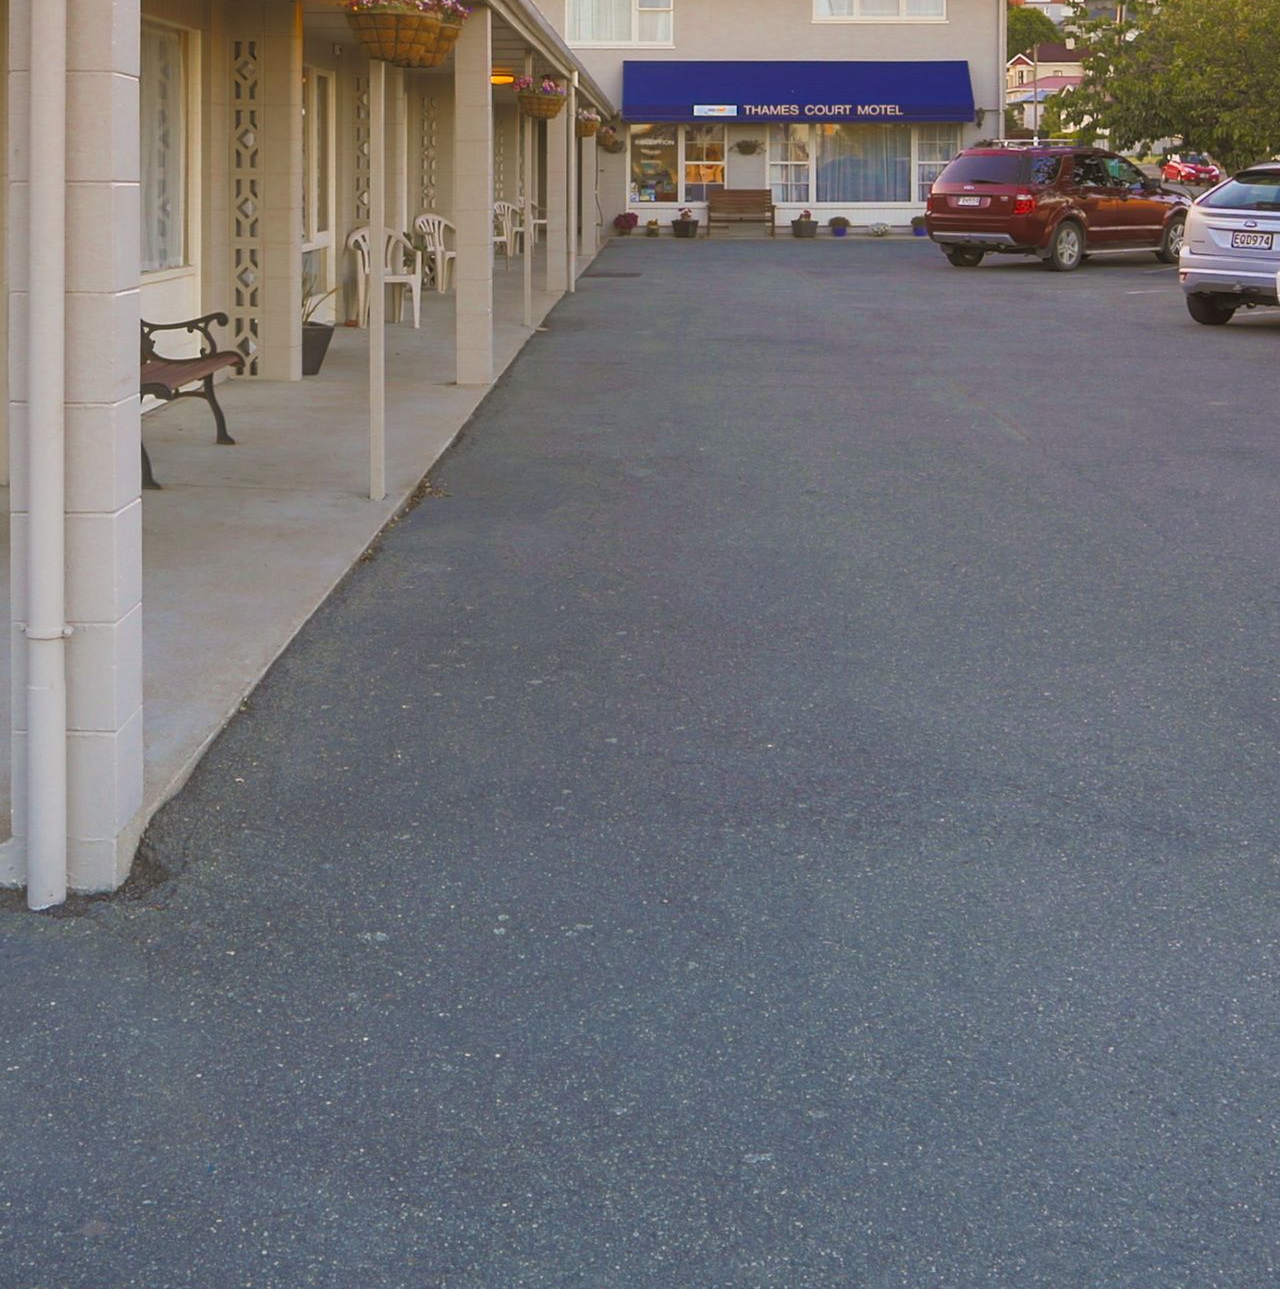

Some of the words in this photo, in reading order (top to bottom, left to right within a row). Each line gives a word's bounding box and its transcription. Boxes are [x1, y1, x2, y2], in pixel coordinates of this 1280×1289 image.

[743, 105, 799, 115] THAMES
[804, 105, 852, 115] COURT
[857, 105, 903, 115] MOTEL
